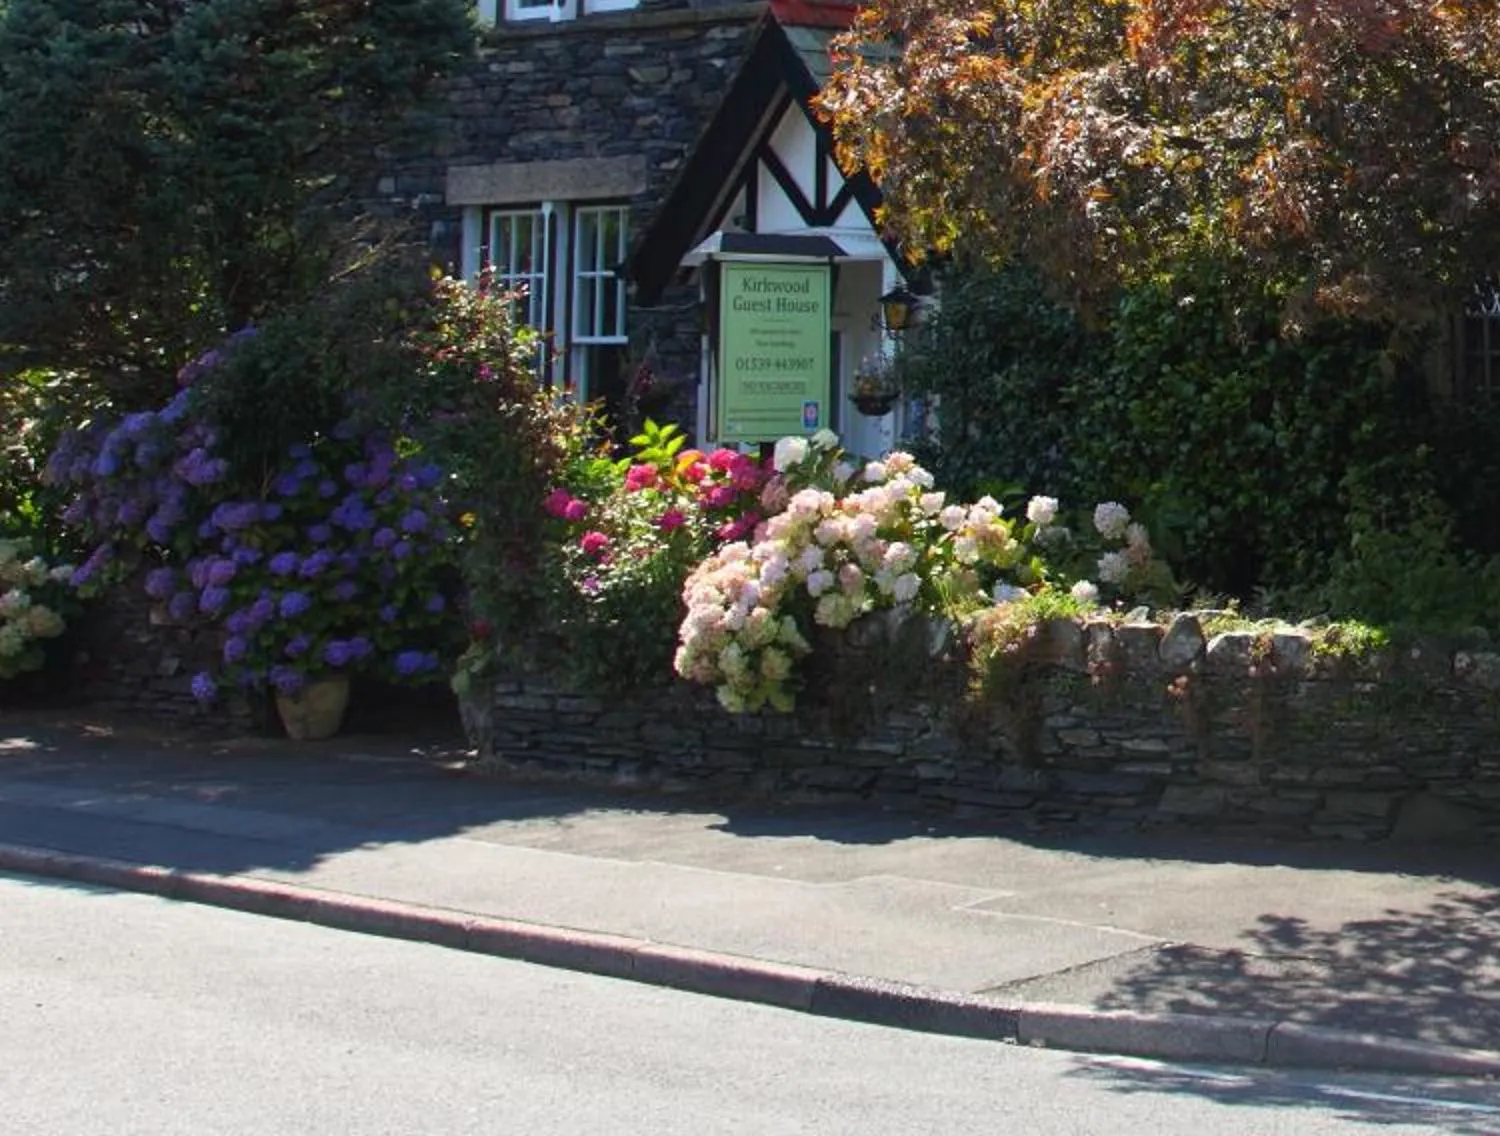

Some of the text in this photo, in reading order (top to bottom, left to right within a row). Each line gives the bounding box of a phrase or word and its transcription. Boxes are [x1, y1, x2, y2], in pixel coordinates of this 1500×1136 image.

[742, 277, 810, 293] Kirkwood
[733, 295, 819, 313] Guest House
